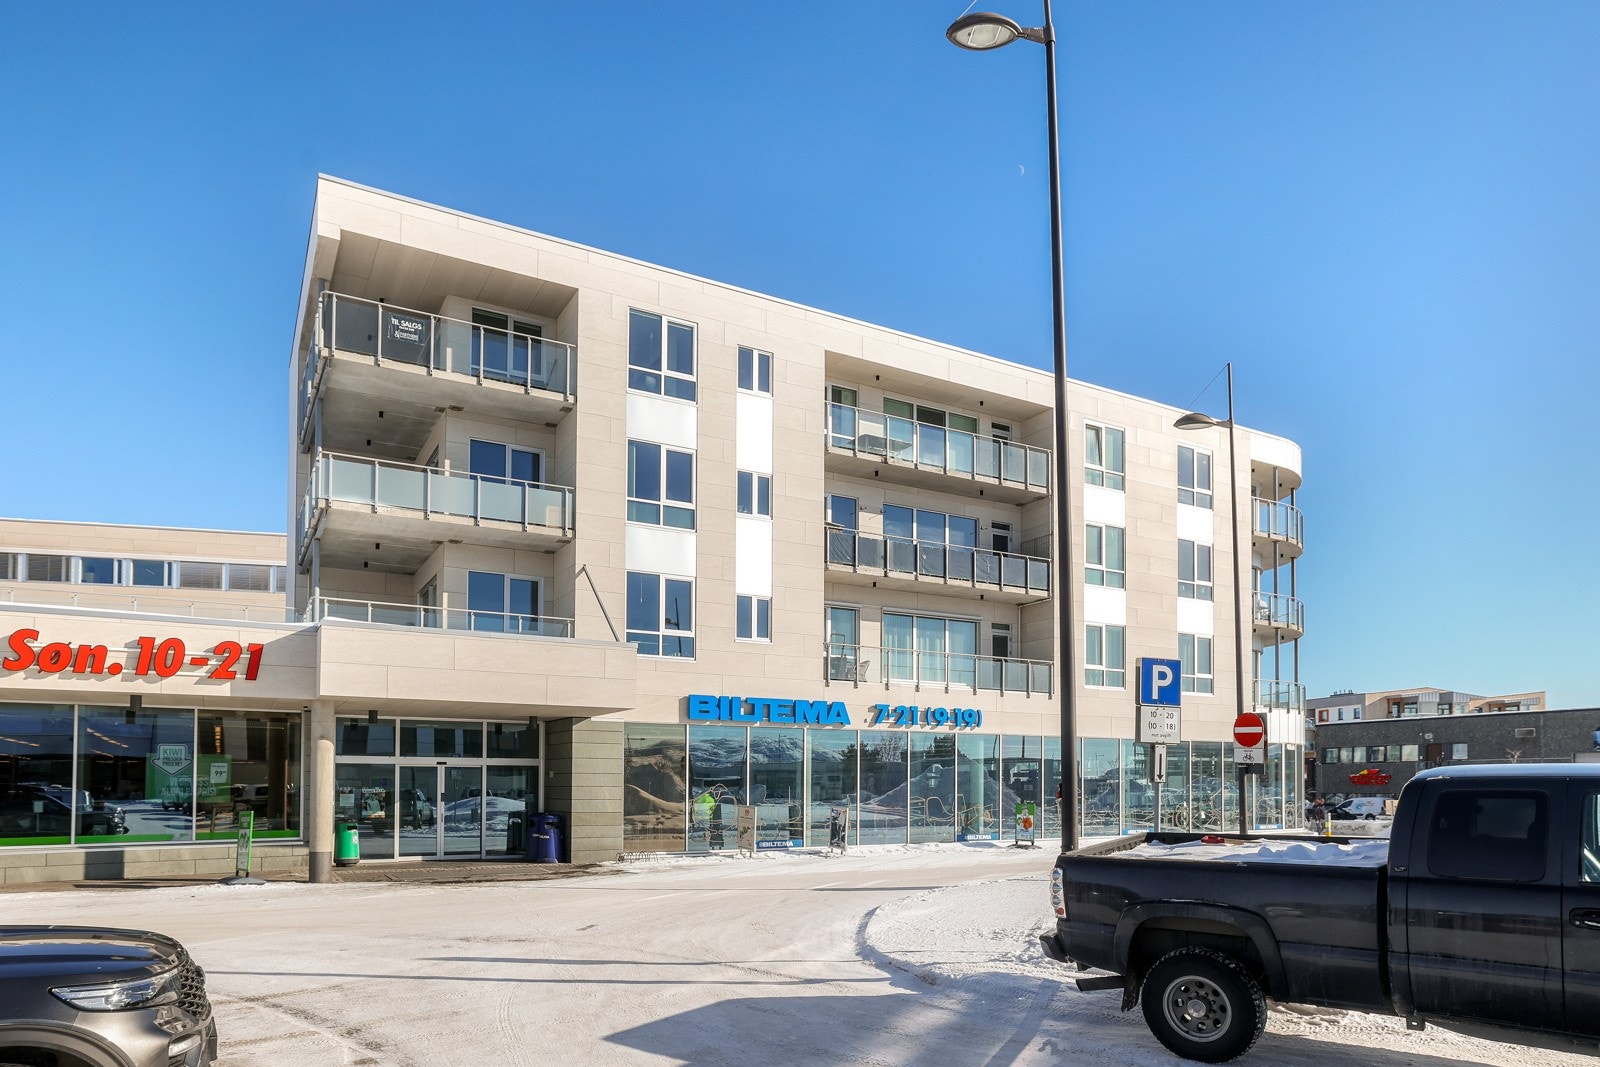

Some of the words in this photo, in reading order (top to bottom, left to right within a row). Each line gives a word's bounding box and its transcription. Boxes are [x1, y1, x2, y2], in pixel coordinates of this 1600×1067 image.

[391, 317, 400, 326] TIL
[400, 320, 422, 330] SALGS
[3, 628, 123, 676] Søn.
[1152, 664, 1173, 700] P
[688, 694, 851, 726] BILTEMA
[875, 704, 919, 726] 7-21
[926, 706, 983, 728] (9-19)
[1148, 721, 1157, 730] (10
[1166, 723, 1176, 731] 18)
[163, 748, 182, 756] KIWI
